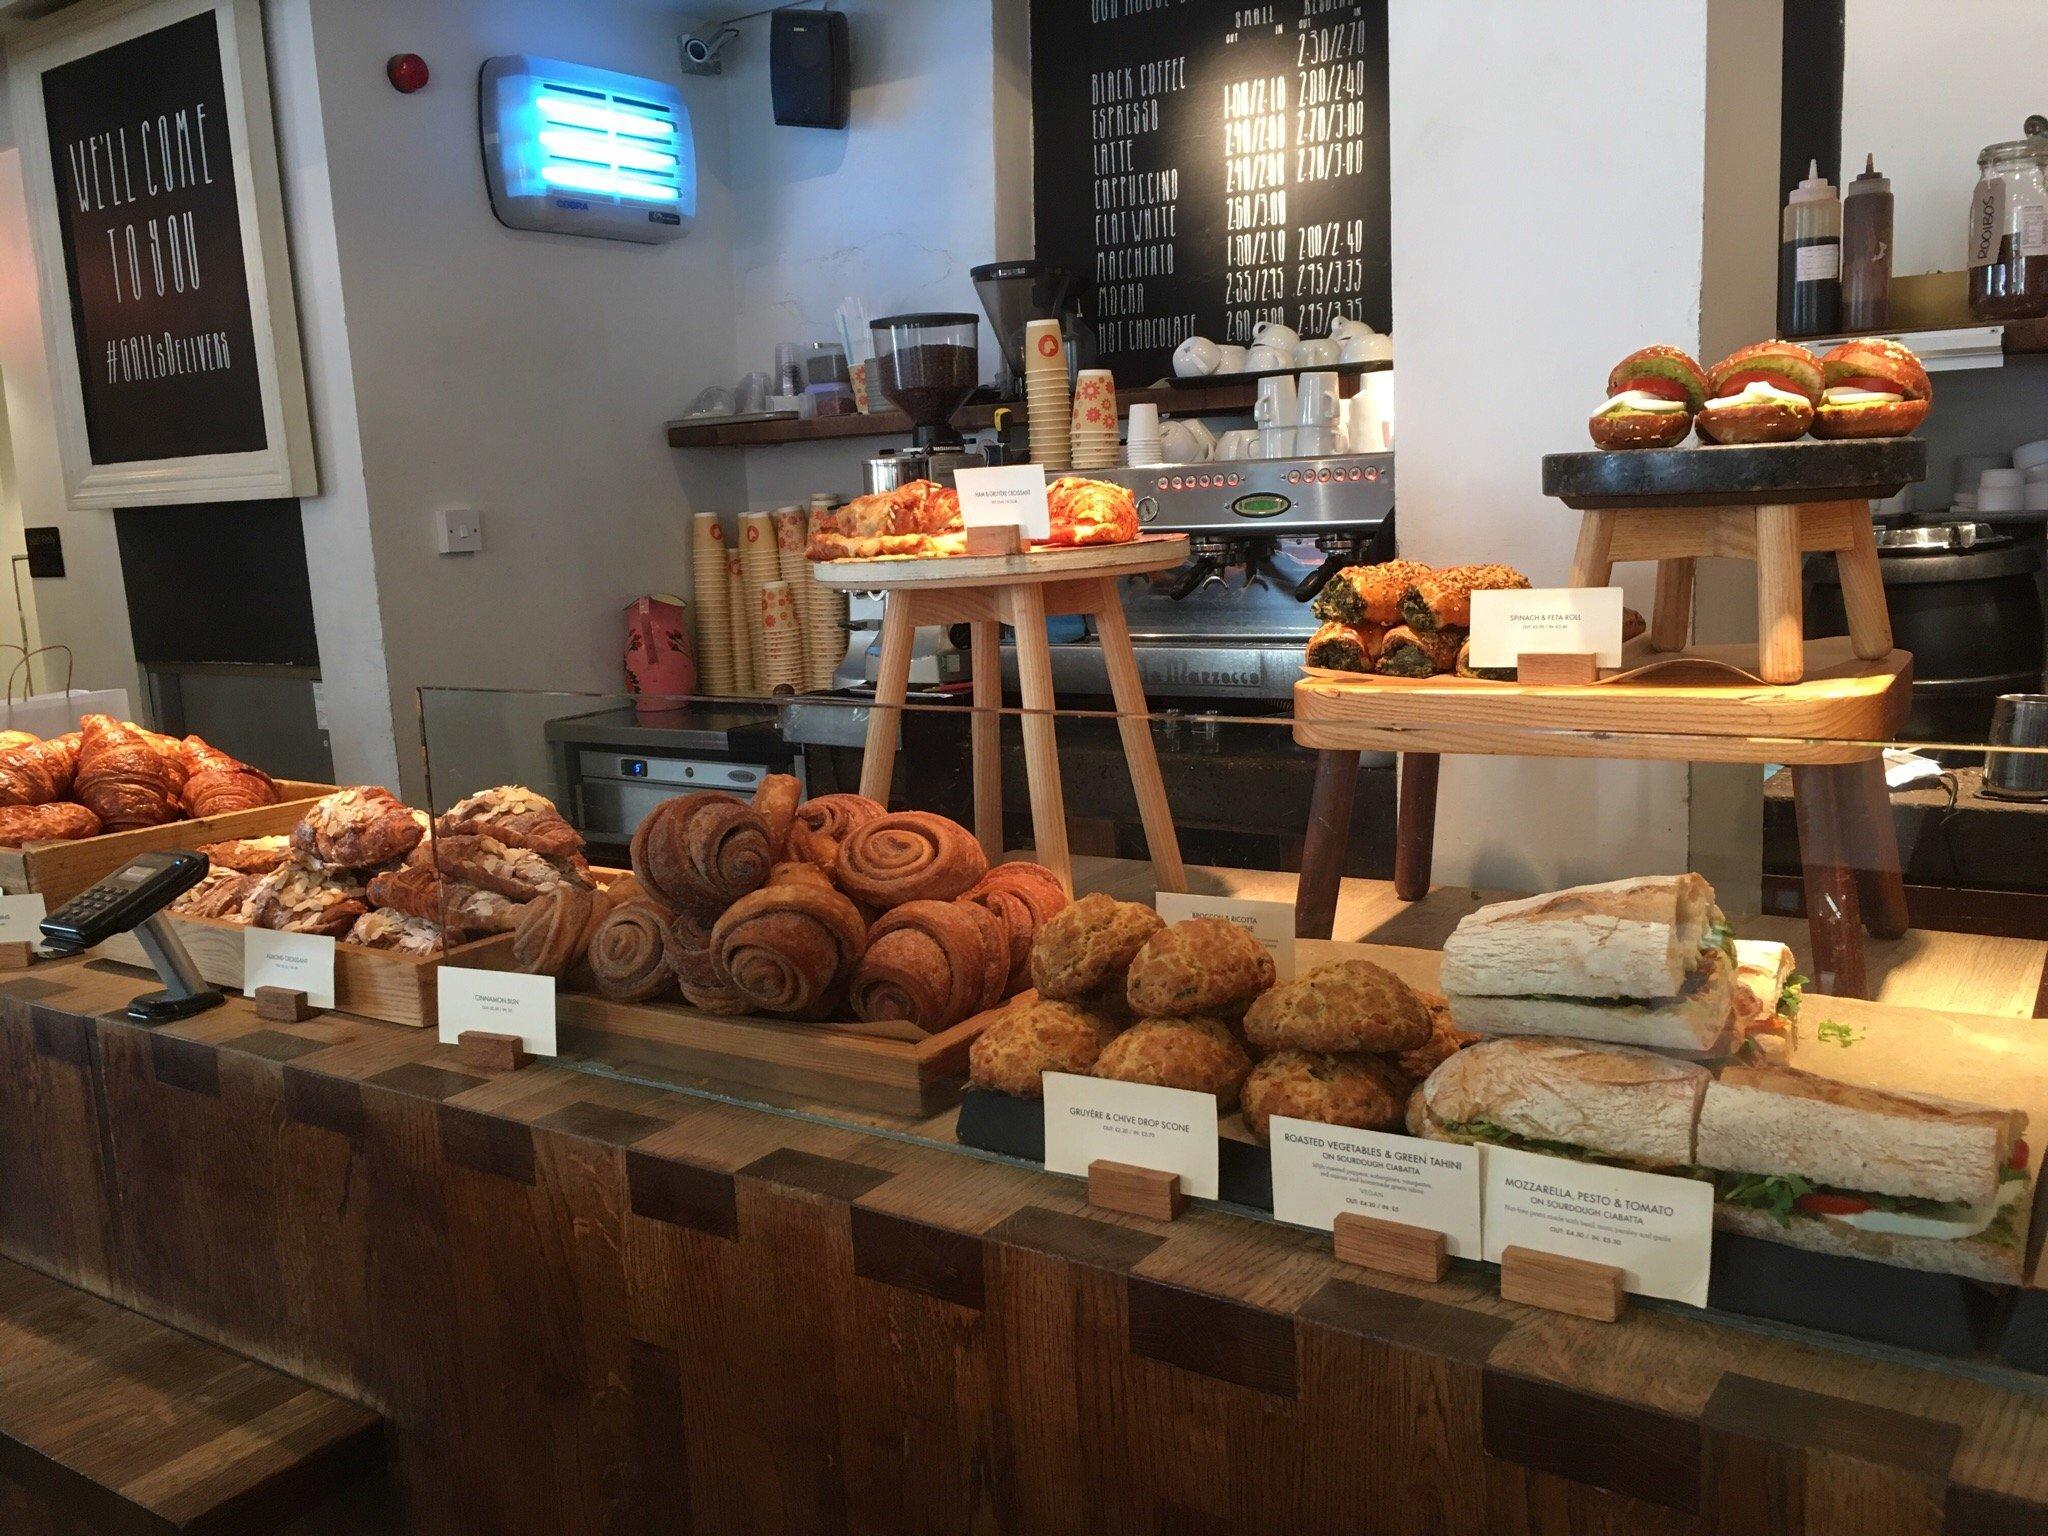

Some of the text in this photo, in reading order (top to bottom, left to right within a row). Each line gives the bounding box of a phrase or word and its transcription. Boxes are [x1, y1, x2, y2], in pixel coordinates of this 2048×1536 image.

[1225, 7, 1362, 44] OUT IN OUT IN
[1235, 5, 1274, 29] SMALL
[1092, 20, 1365, 105] BLACK COFFEE 2.30/2.70
[1092, 99, 1158, 140] ESPRESSO
[1298, 60, 1364, 108] 2.00/2.40
[69, 103, 213, 212] WE'LL COME
[1093, 140, 1134, 175] LATTE
[1296, 100, 1364, 145] 2.70/3.00
[1095, 168, 1178, 210] CAPPUCCINO
[1297, 139, 1363, 183] 2.70/3.00
[1095, 211, 1126, 246] FLAT
[1131, 205, 1176, 242] WHITE
[1977, 195, 1995, 259] ROOIBOS
[107, 211, 200, 303] TO YOU
[1097, 243, 1174, 283] MACCHIATO
[1227, 229, 1286, 266] 1.80/2.10
[1098, 283, 1144, 317] MOCHA
[1098, 321, 1122, 355] HOT
[1128, 314, 1196, 351] CHOCOLATE
[634, 763, 641, 773] 5
[1231, 915, 1258, 924] RICOTTA
[1105, 1112, 1111, 1120] &
[1113, 1113, 1136, 1125] CHIVE
[1138, 1117, 1160, 1128] DROP
[1161, 1121, 1190, 1133] SCONE
[1284, 1133, 1463, 1171] ROASTED VEGETABLES & GREEN TAHINI
[1322, 1152, 1335, 1161] ON
[1336, 1154, 1384, 1169] SOURDOUGH
[1386, 1162, 1421, 1176] CIABATTA
[1505, 1178, 1674, 1217] MOZZARELLA, PESTO & TOMATO
[1530, 1196, 1644, 1225] ON SOURDOUGH CIABATTA
